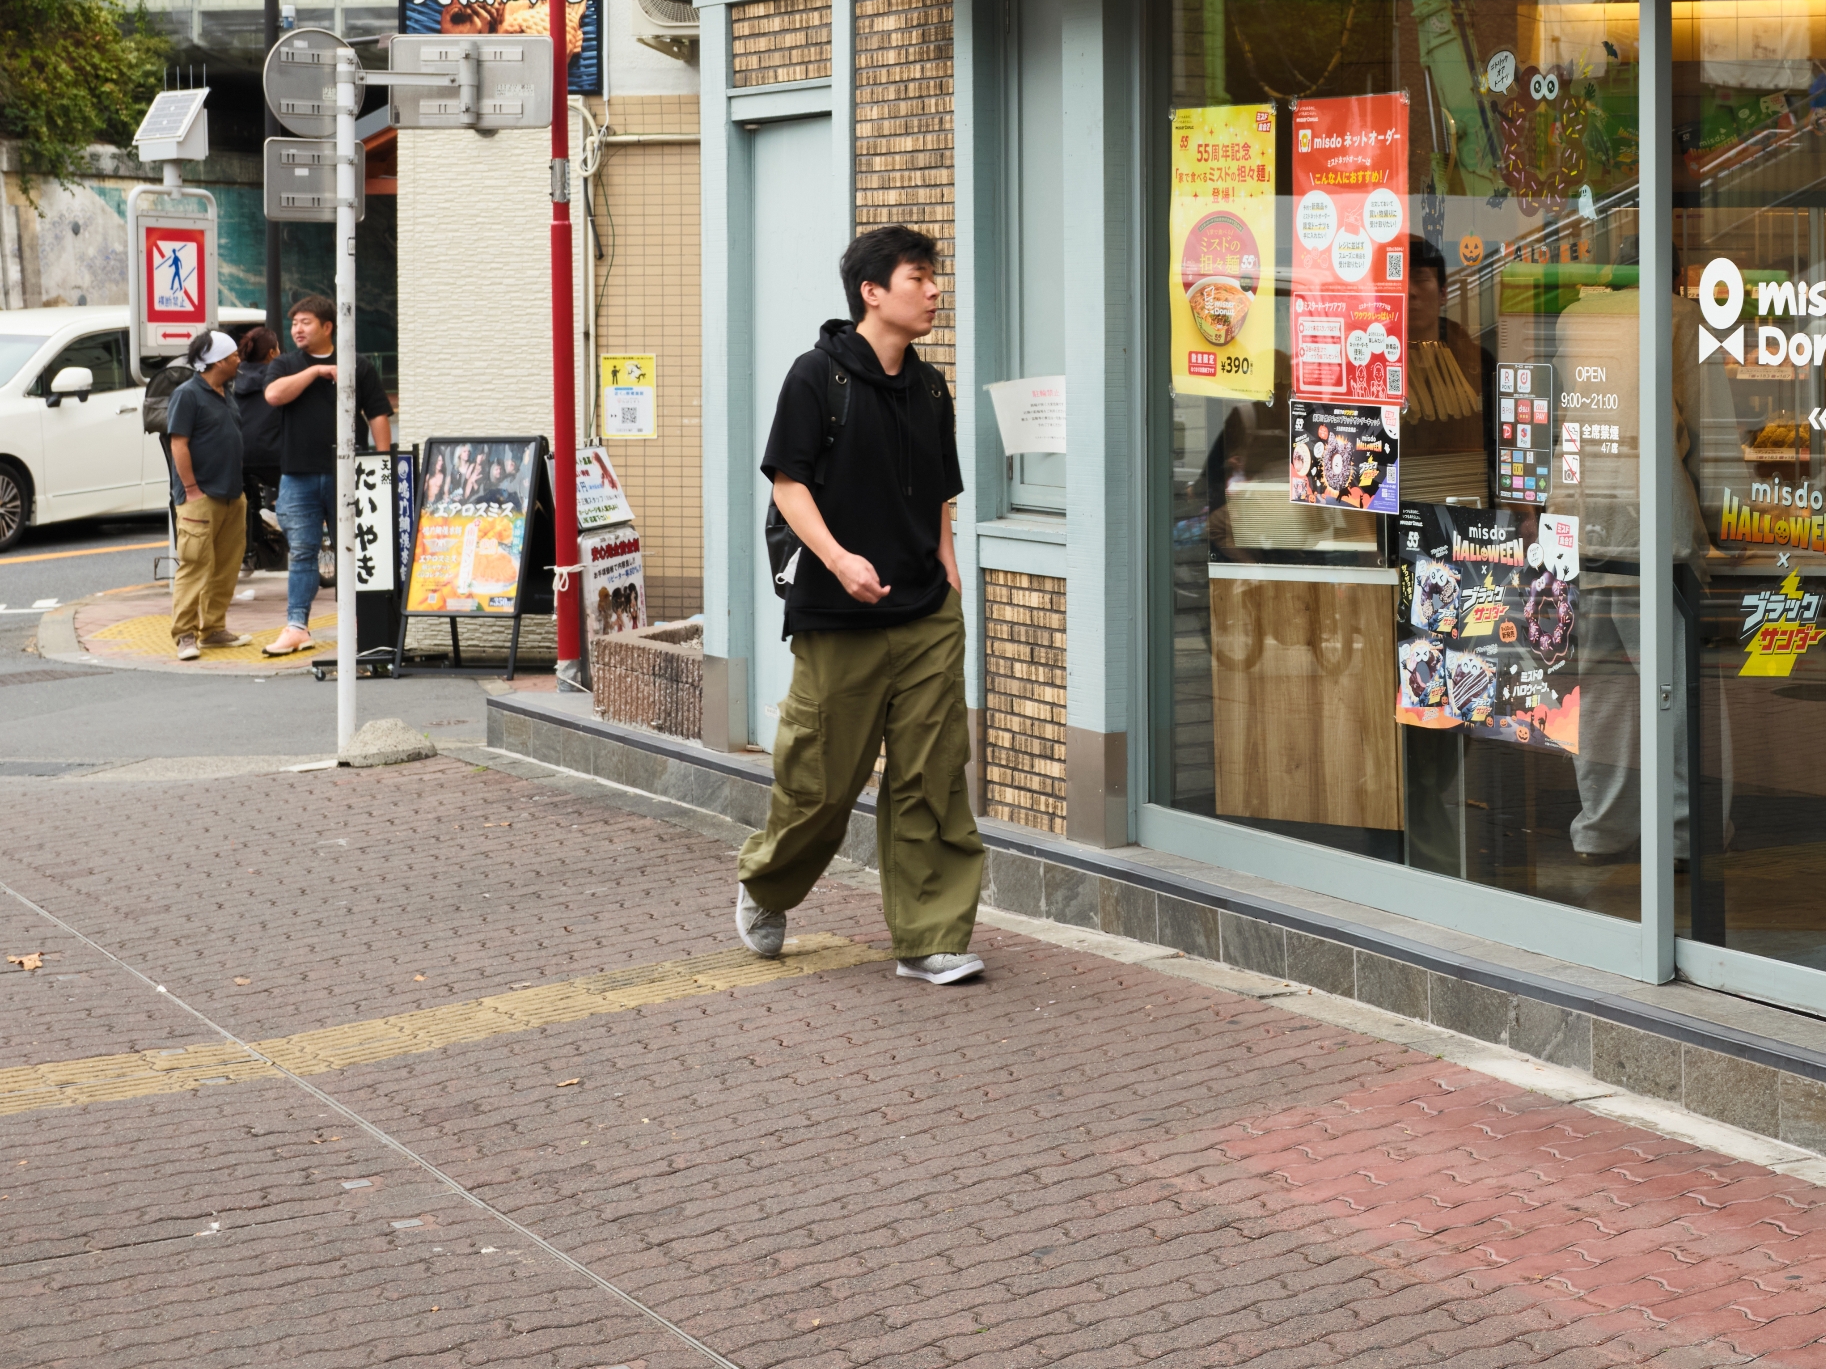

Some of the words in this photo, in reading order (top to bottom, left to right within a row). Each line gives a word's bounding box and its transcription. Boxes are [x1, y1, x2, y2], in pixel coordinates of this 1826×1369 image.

[1180, 135, 1189, 149] 55
[1313, 132, 1342, 149] misdo
[1343, 127, 1401, 148] ネットオーダー
[1698, 133, 1726, 148] misdo
[1196, 142, 1252, 163] 55周年記念
[1327, 155, 1371, 168] ミスドネットオーダーは
[1314, 169, 1383, 185] こんな人におすすめ!
[1211, 186, 1235, 204] 登場!
[1200, 236, 1241, 253] ミスドの
[1338, 242, 1365, 250] レジに並ばず
[1503, 239, 1590, 265] HALLOWEEN
[1199, 253, 1241, 275] 担々麺
[1241, 254, 1255, 269] 55
[158, 295, 187, 309] 横断禁止
[1304, 302, 1347, 311] ミスタードーナツアプリ
[1214, 308, 1235, 316] Donut
[1191, 353, 1215, 364] 数量限定
[1221, 356, 1250, 375] ¥390
[1575, 366, 1606, 383] OPEN
[1535, 412, 1546, 420] PAY
[1361, 434, 1377, 442] misdo
[1582, 424, 1620, 441] 全席禁煙
[1600, 442, 1619, 454] 47席
[1752, 477, 1824, 511] misdo
[434, 501, 515, 518] エアロスミス
[355, 461, 379, 585] たいやき
[1557, 523, 1570, 533] ミスド
[1468, 523, 1507, 541] misdo
[1452, 530, 1525, 567] HALLOWEEN
[1460, 584, 1507, 615] ブラック
[1473, 605, 1509, 624] サンダー
[1740, 590, 1824, 640] ブラック
[1520, 669, 1544, 682] ミスドの
